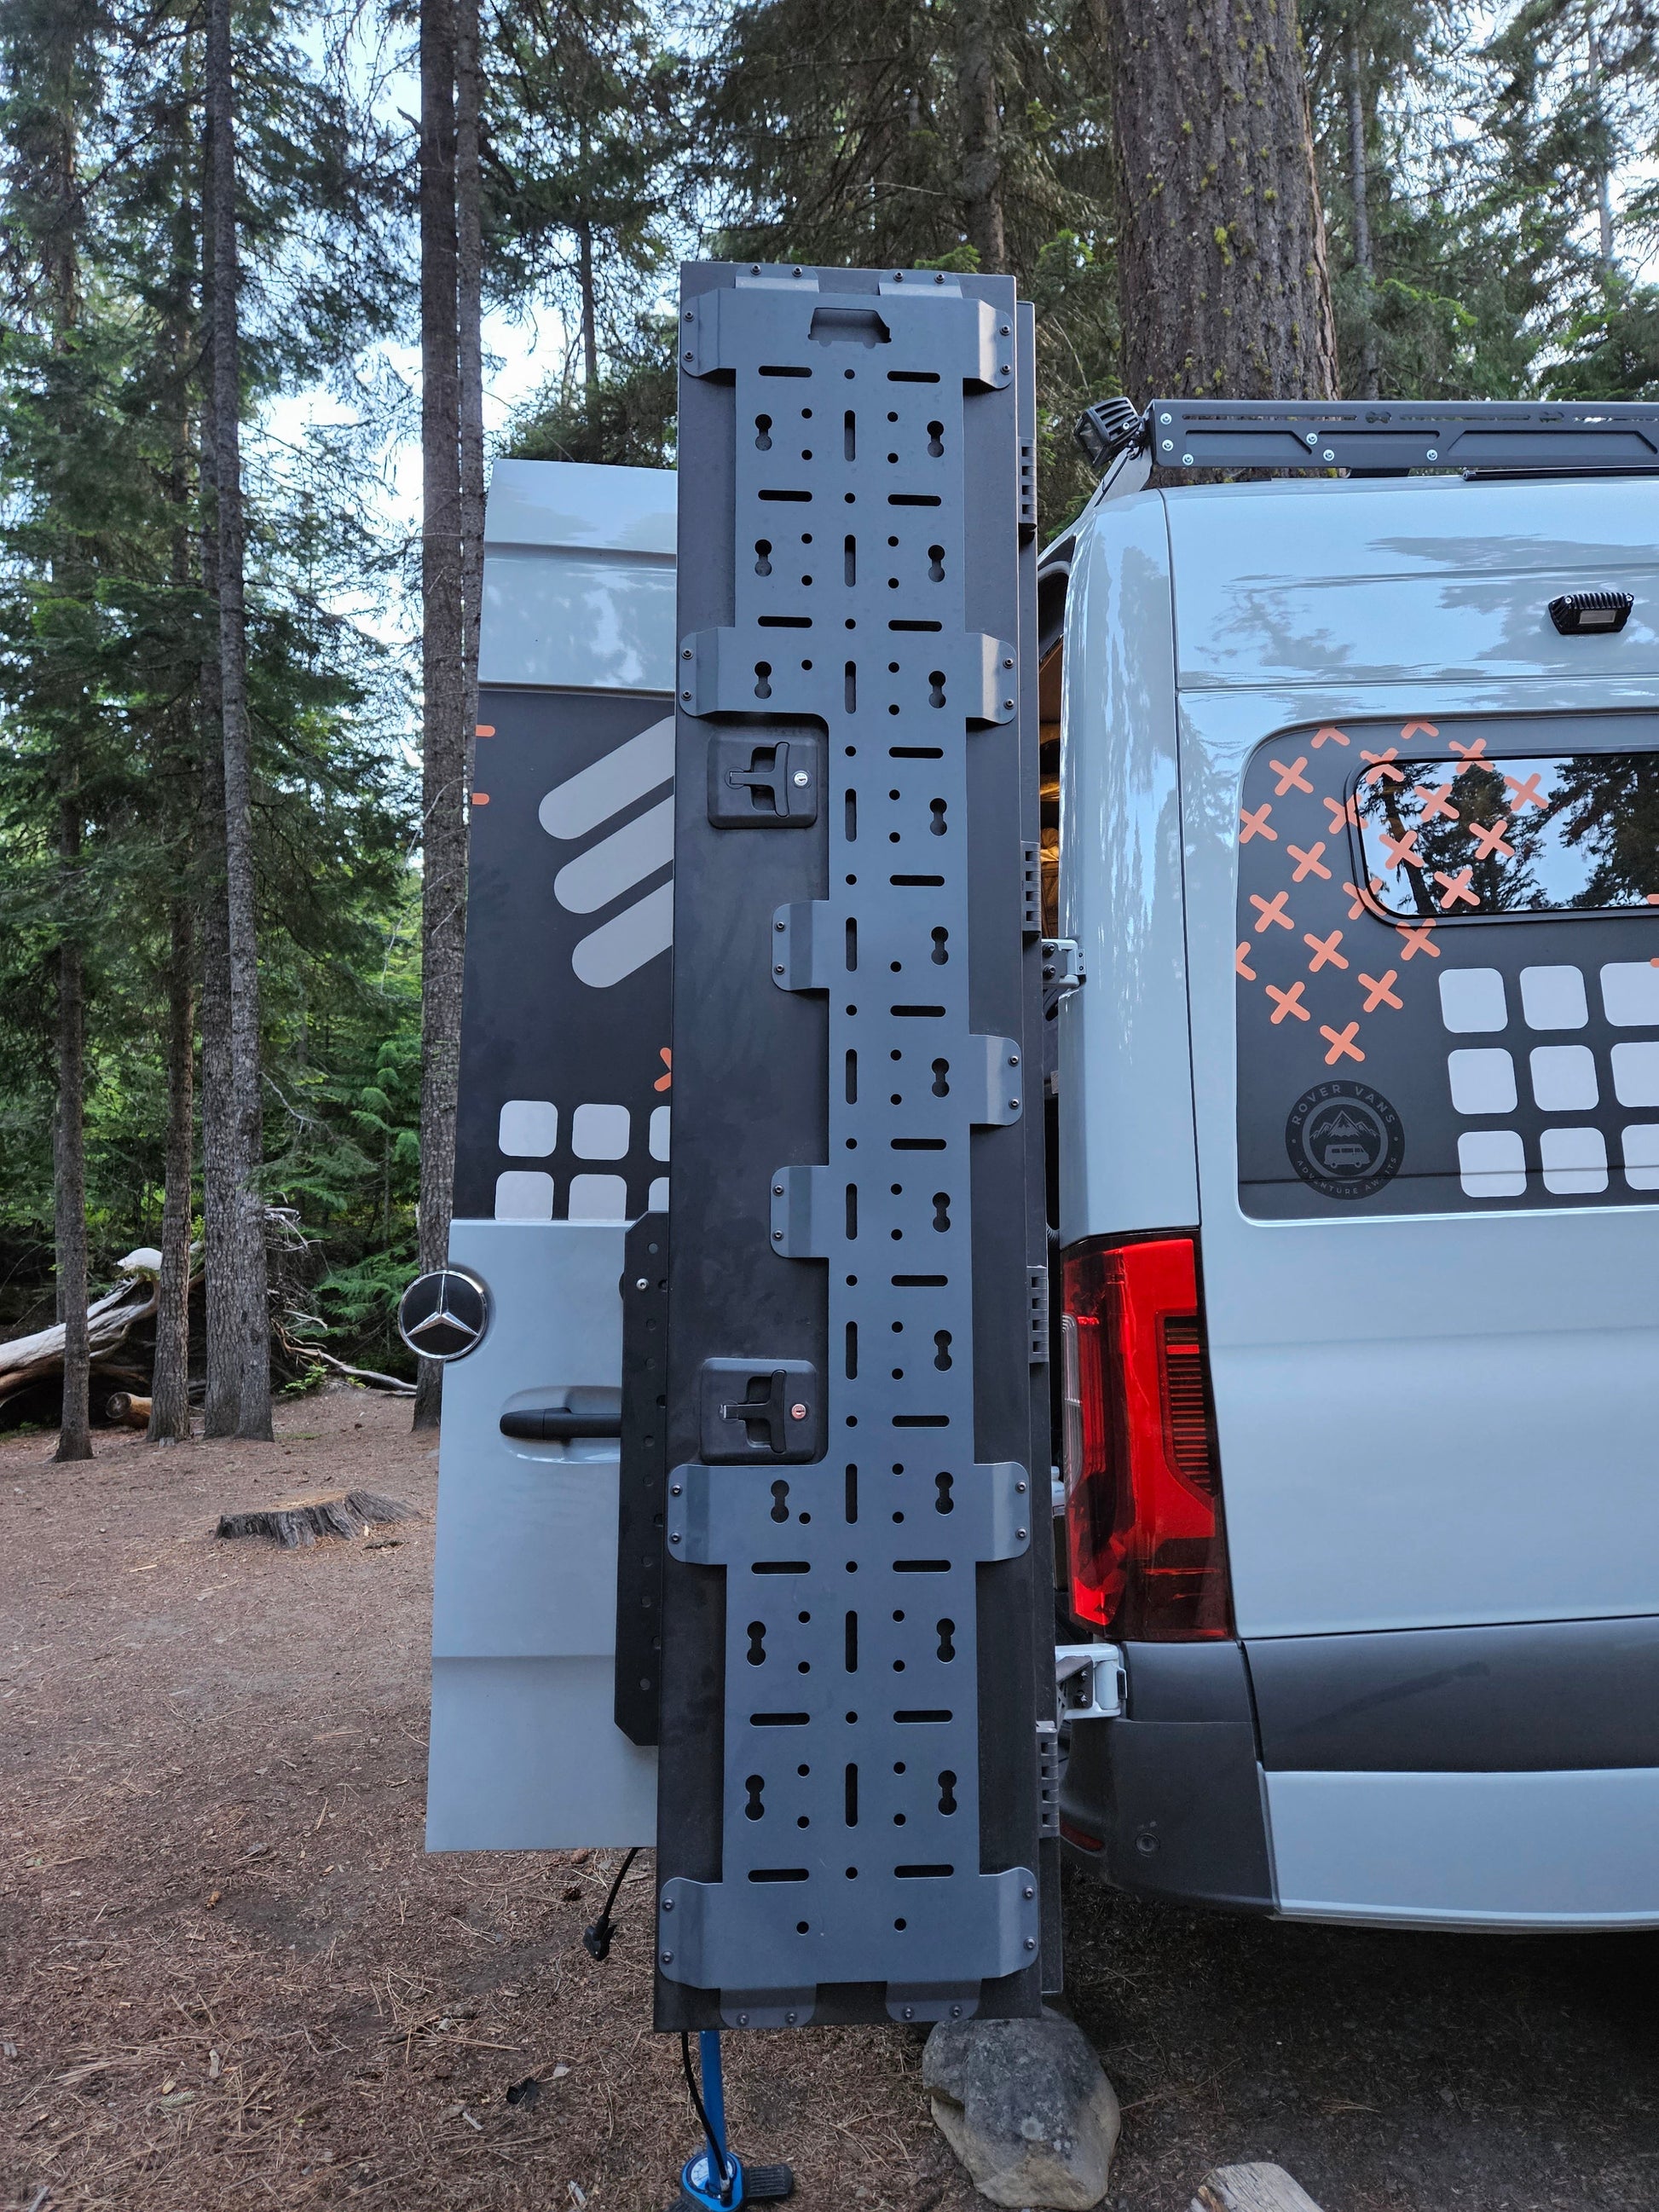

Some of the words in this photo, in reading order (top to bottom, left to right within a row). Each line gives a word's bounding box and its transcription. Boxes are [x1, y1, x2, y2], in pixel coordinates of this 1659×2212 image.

[1292, 1084, 1341, 1125] ROVER
[1355, 1086, 1396, 1123] VANS
[1365, 1157, 1396, 1191] AWITS
